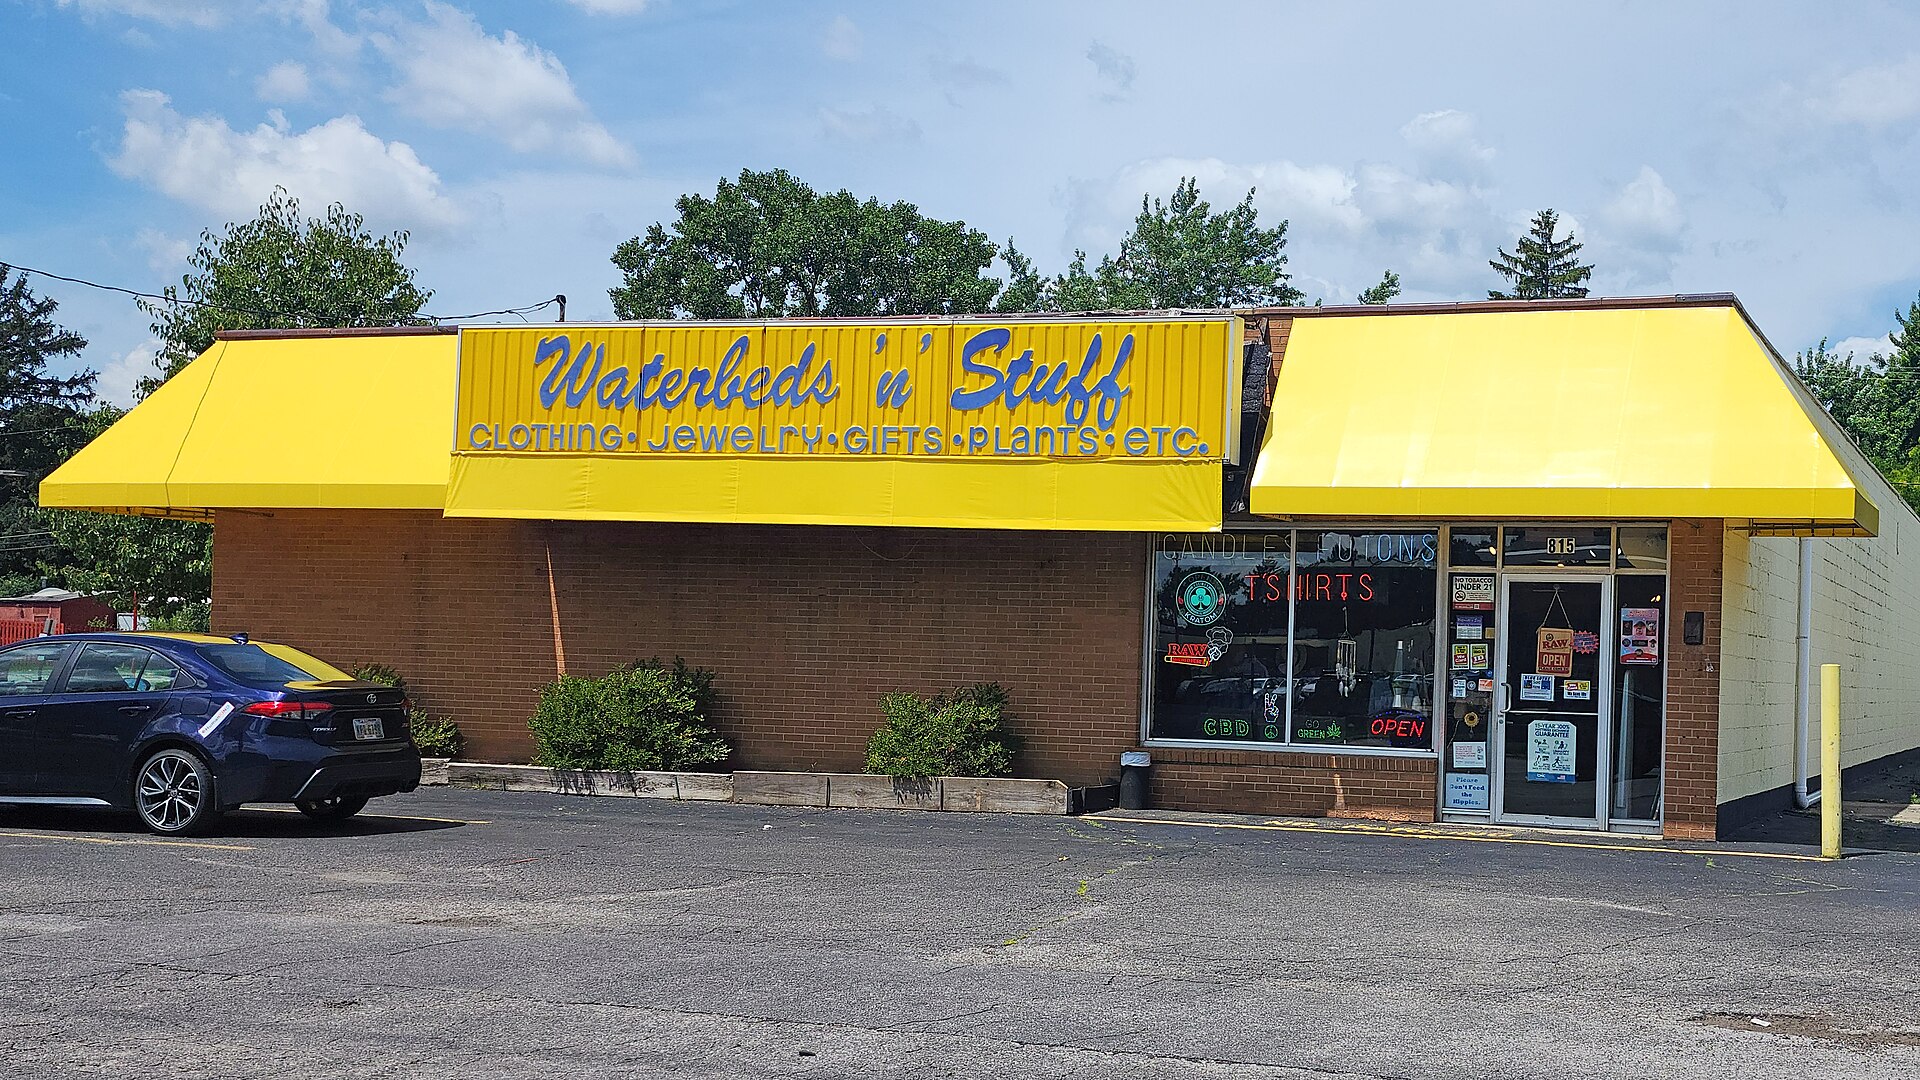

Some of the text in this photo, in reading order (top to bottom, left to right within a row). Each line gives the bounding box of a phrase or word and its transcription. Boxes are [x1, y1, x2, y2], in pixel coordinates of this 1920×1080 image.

[534, 334, 840, 411] Waterbeds
[950, 327, 1135, 431] Stuff
[843, 425, 943, 454] GIFTS
[1316, 533, 1436, 561] FUTONS
[1548, 538, 1574, 553] 815
[1455, 583, 1492, 591] UNDER 21
[1184, 611, 1218, 624] KRATOM
[1167, 643, 1208, 657] RAW
[1542, 639, 1569, 649] RAW
[1542, 654, 1567, 666] OPEN
[1203, 718, 1249, 736] CBD
[1305, 719, 1320, 729] GO
[1371, 719, 1425, 738] OPEN
[1297, 728, 1326, 739] GREEN
[1534, 730, 1570, 738] GUARANTEE
